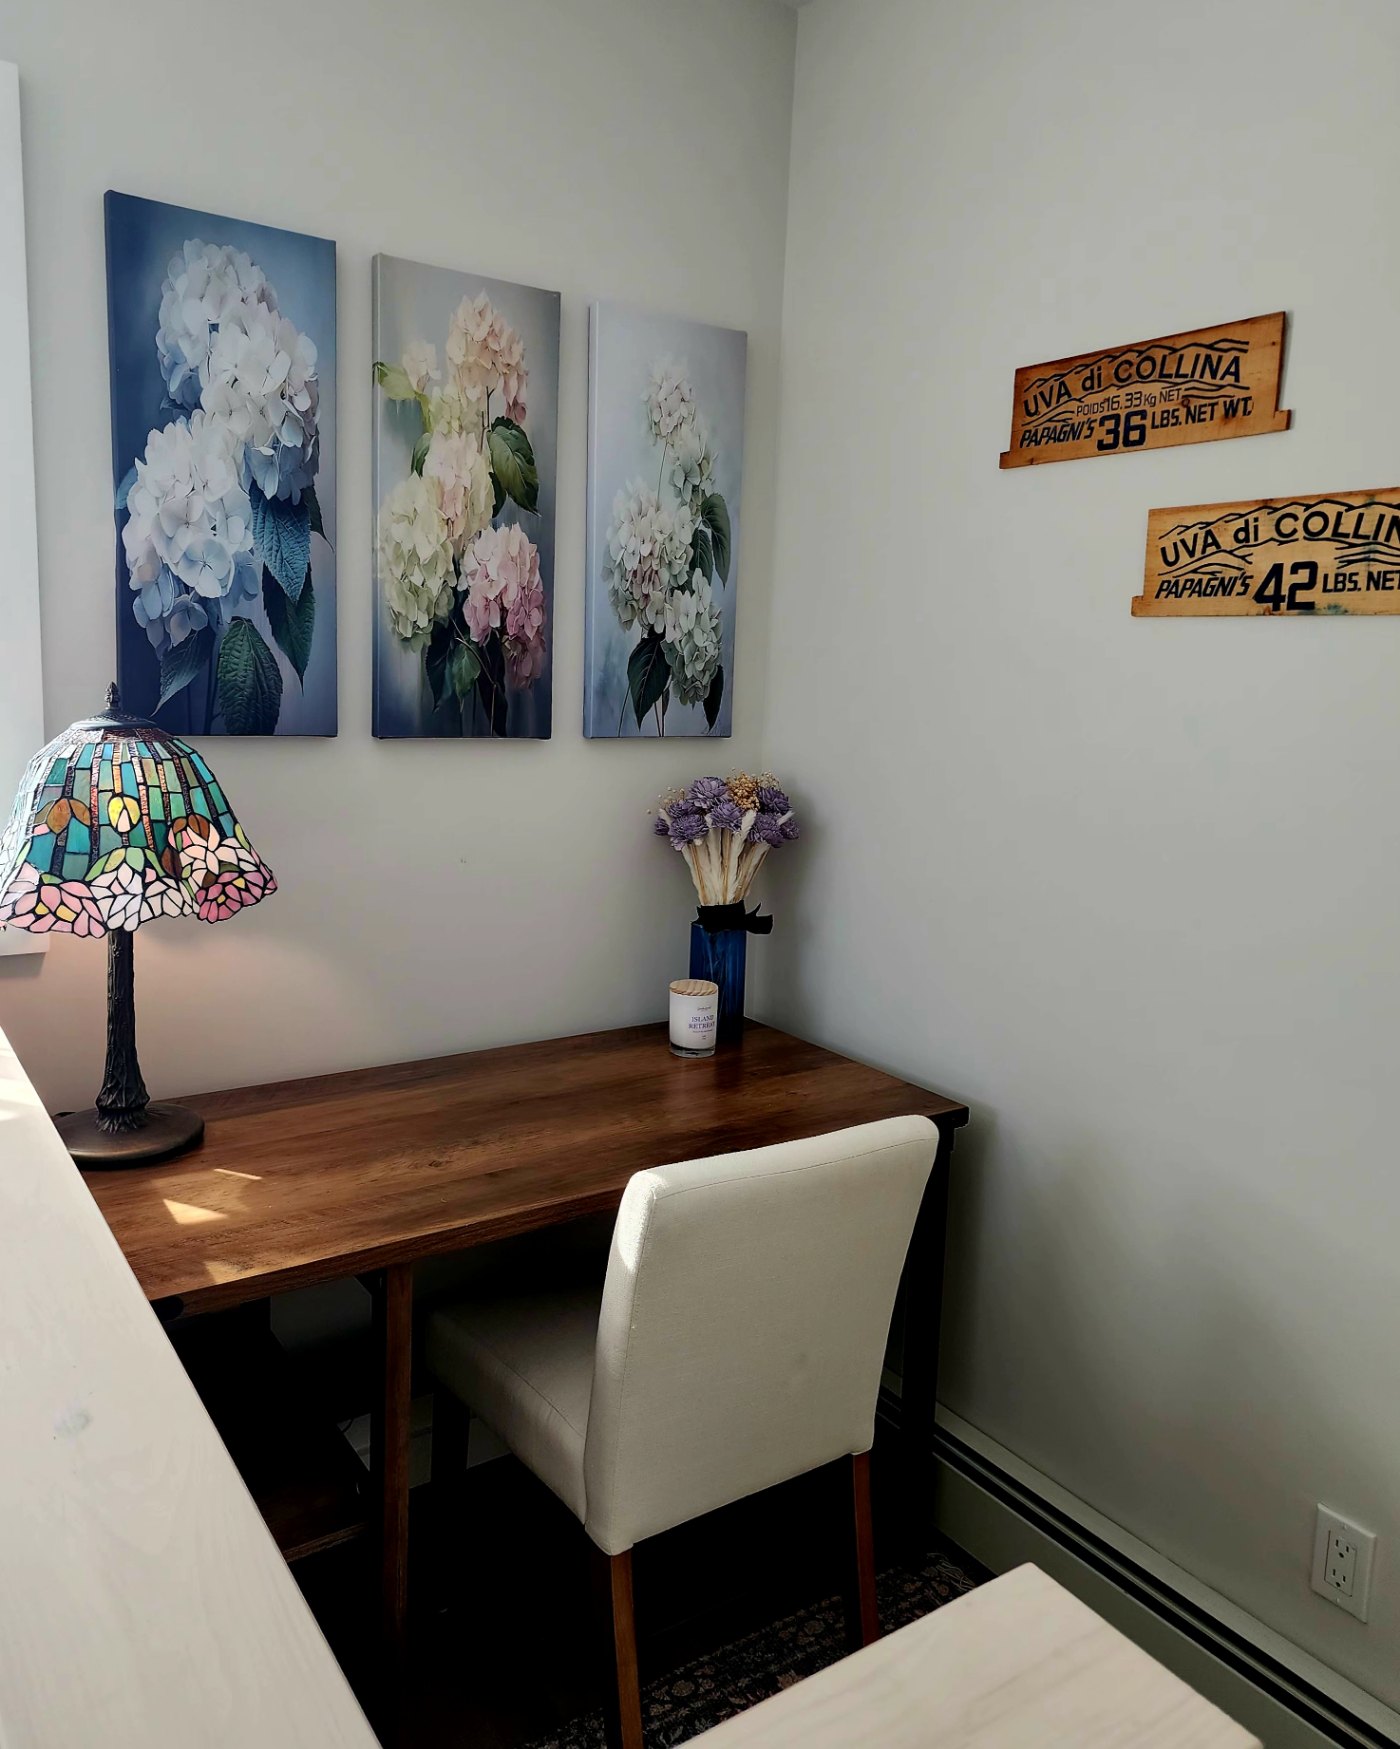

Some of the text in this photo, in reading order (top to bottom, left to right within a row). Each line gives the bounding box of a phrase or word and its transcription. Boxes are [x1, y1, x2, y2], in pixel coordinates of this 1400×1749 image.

[1023, 353, 1241, 417] UVA di COLLINA
[1076, 388, 1182, 416] POIDS 16.33 Kg NET
[1020, 418, 1097, 448] PAPAGNI'S
[1097, 410, 1147, 451] 36
[1151, 408, 1182, 429] LBS.
[1185, 402, 1219, 424] NET
[1160, 529, 1222, 567] UVA
[1233, 517, 1259, 543] di
[1155, 571, 1254, 599] PAPAGNI'S
[1252, 561, 1318, 611] 42
[1322, 572, 1361, 593] LBS.
